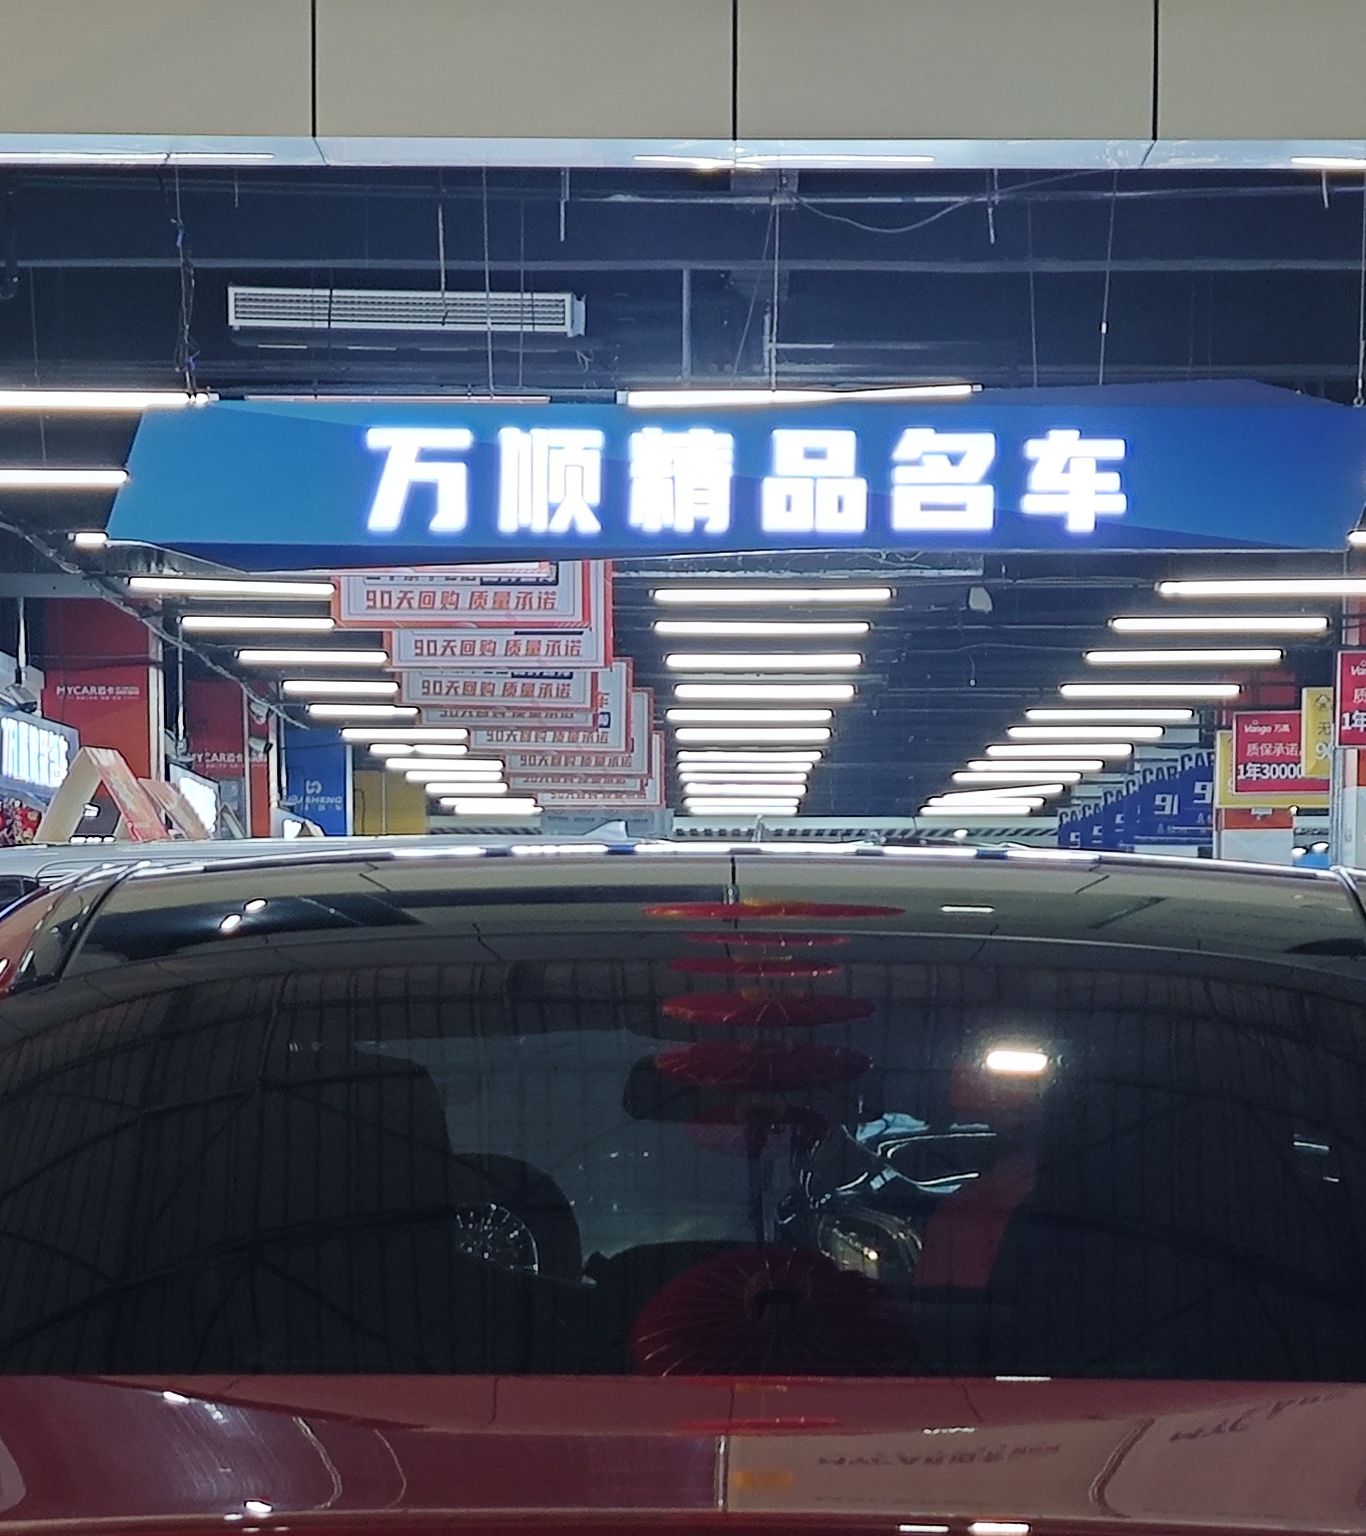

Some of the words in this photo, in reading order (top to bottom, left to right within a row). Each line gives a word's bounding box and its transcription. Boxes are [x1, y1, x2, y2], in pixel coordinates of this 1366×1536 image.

[364, 427, 1128, 534] 万顺精品名车
[366, 589, 459, 610] 90天回购
[468, 589, 557, 611] 质量承诺
[415, 639, 496, 657] 90天回购
[504, 638, 582, 657] 质量承诺
